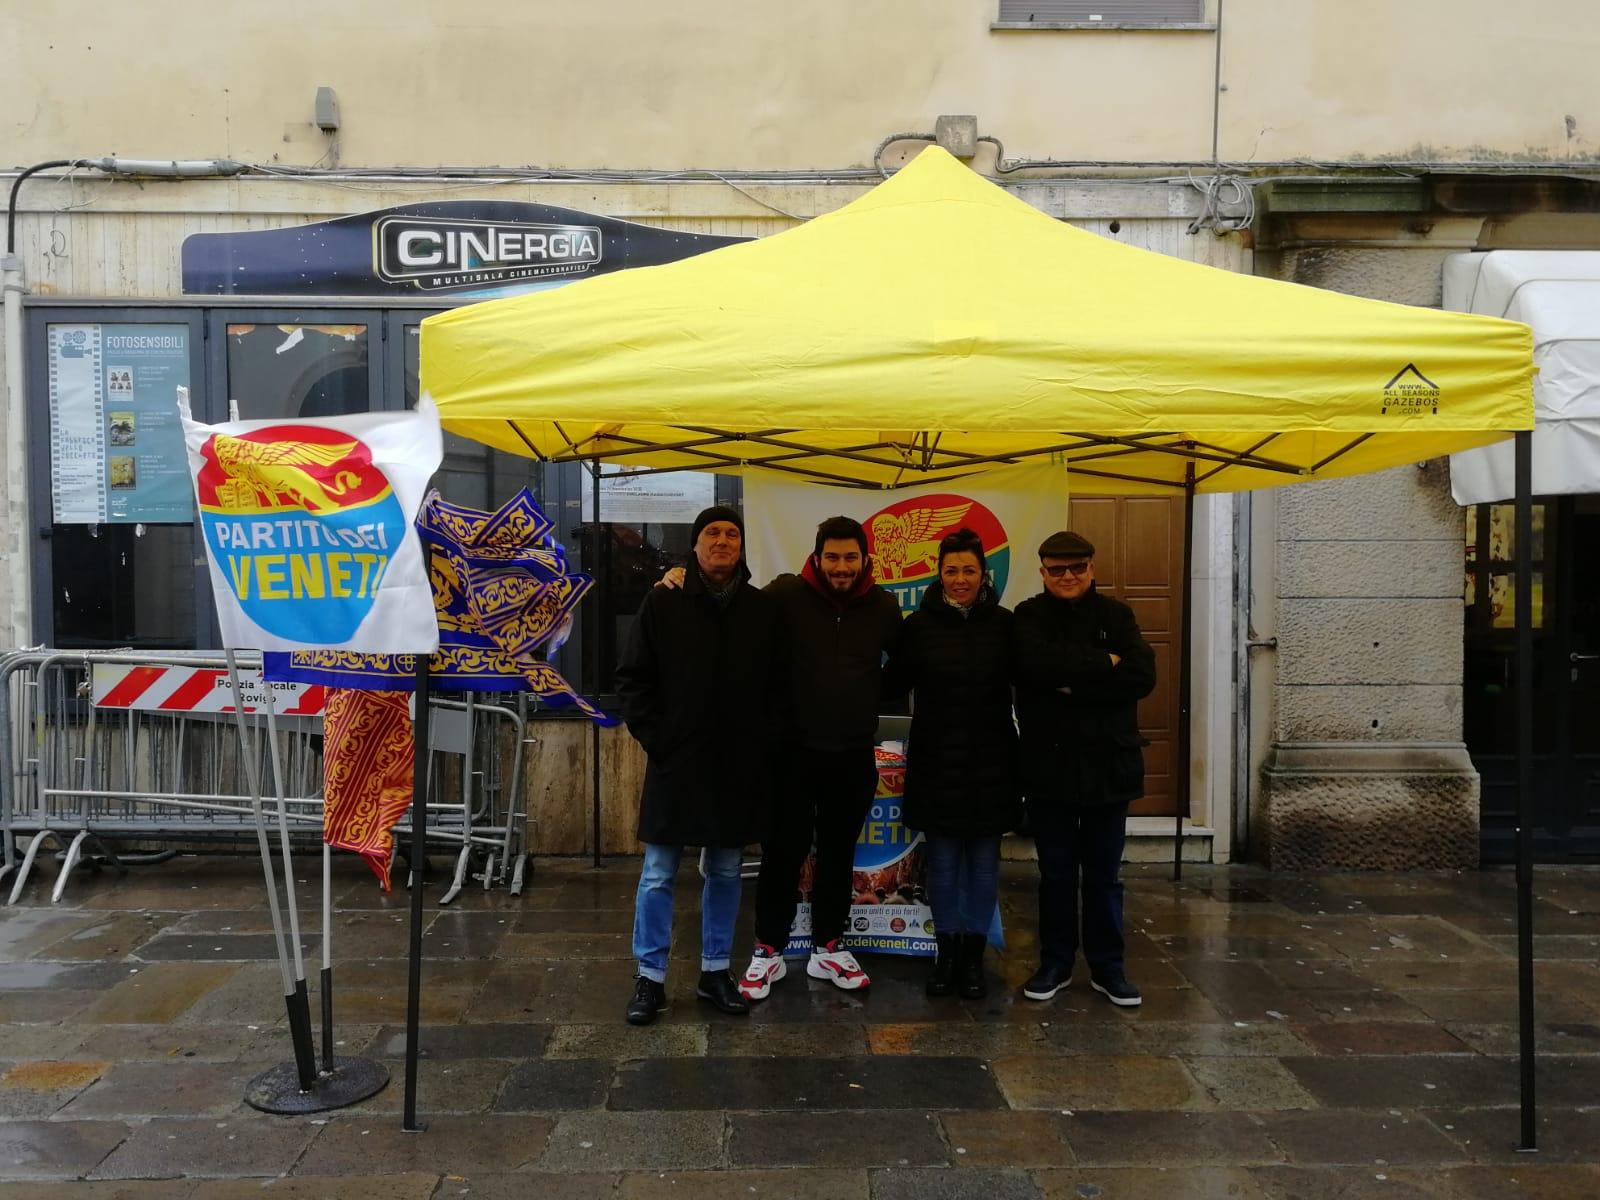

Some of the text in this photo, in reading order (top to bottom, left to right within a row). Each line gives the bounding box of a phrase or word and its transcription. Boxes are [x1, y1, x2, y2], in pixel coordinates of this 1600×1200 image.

[397, 227, 596, 273] CINERGIA
[432, 263, 586, 286] MULTISALA CINEMATOGRAFICA
[107, 336, 185, 349] FOTOSENSIBILI
[1384, 398, 1439, 406] GAZEBOS
[336, 522, 388, 550] DEI
[227, 552, 388, 600] VENETI
